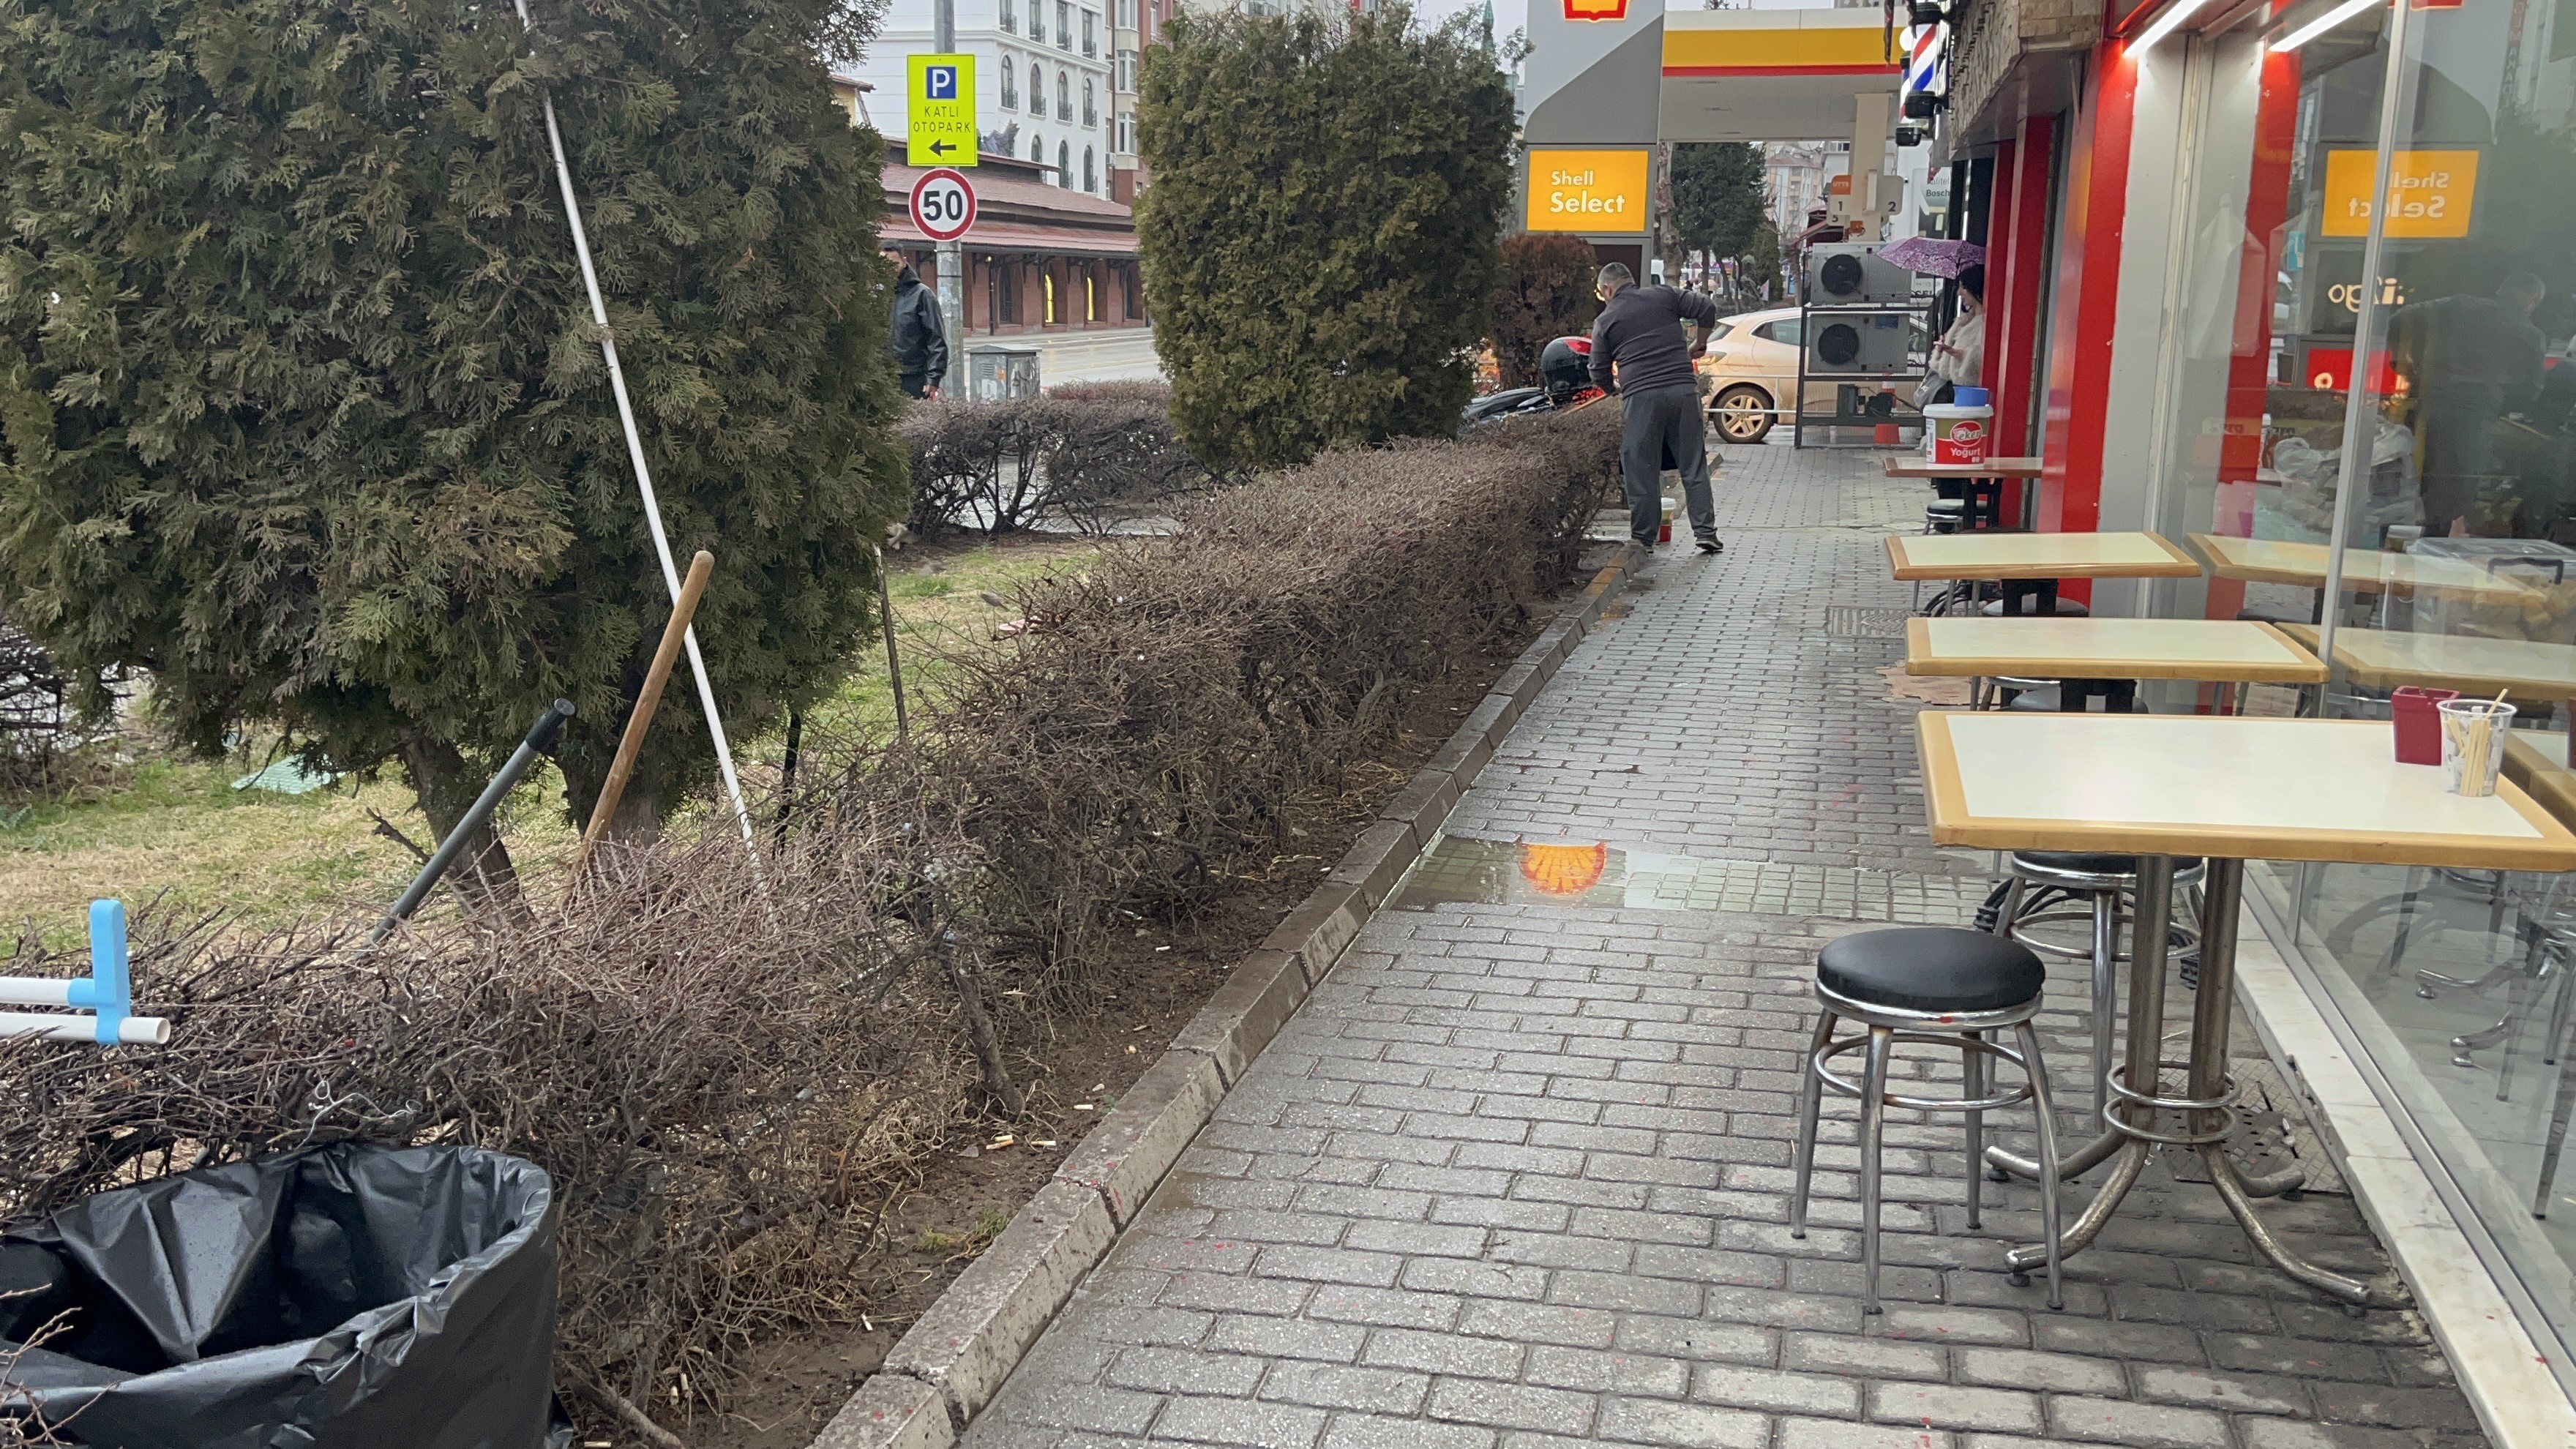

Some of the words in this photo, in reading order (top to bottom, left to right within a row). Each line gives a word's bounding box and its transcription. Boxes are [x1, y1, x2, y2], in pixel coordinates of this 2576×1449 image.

[932, 69, 950, 97] P
[924, 106, 959, 117] KATLI
[913, 121, 971, 133] OTOPARK
[1551, 170, 1594, 186] Shell
[1926, 189, 1950, 197] Bosch
[923, 190, 963, 221] 50
[1550, 190, 1625, 213] Select
[1838, 201, 1843, 211] 1
[1888, 201, 1896, 211] 2
[1958, 430, 1980, 440] eker
[1950, 447, 1980, 458] Yoğurt
